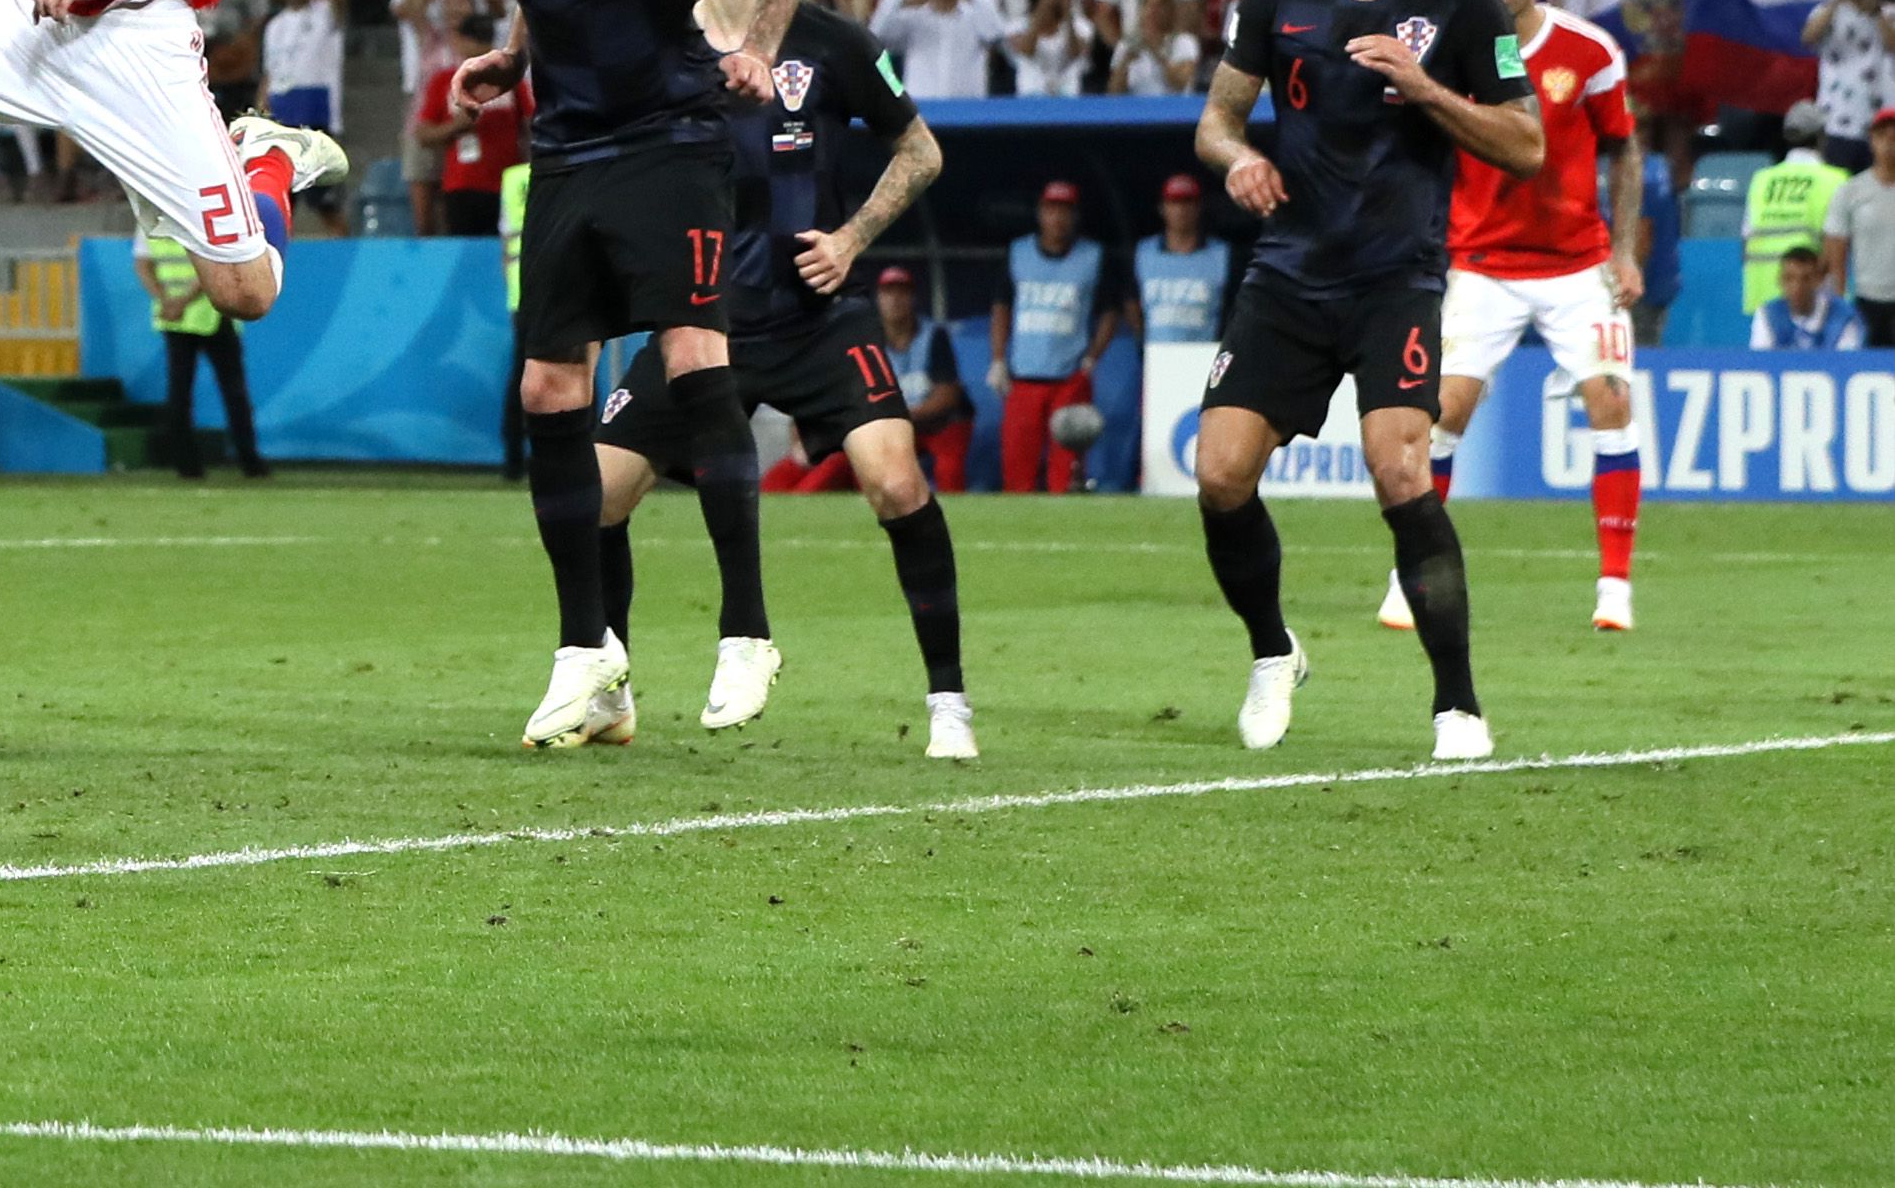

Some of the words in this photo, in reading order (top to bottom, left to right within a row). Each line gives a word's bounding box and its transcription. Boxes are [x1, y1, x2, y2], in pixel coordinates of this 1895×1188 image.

[1287, 58, 1309, 110] 6
[198, 182, 240, 246] 2
[686, 228, 724, 287] 17
[846, 343, 896, 389] 11
[1401, 326, 1429, 375] 6
[1590, 322, 1628, 363] 10
